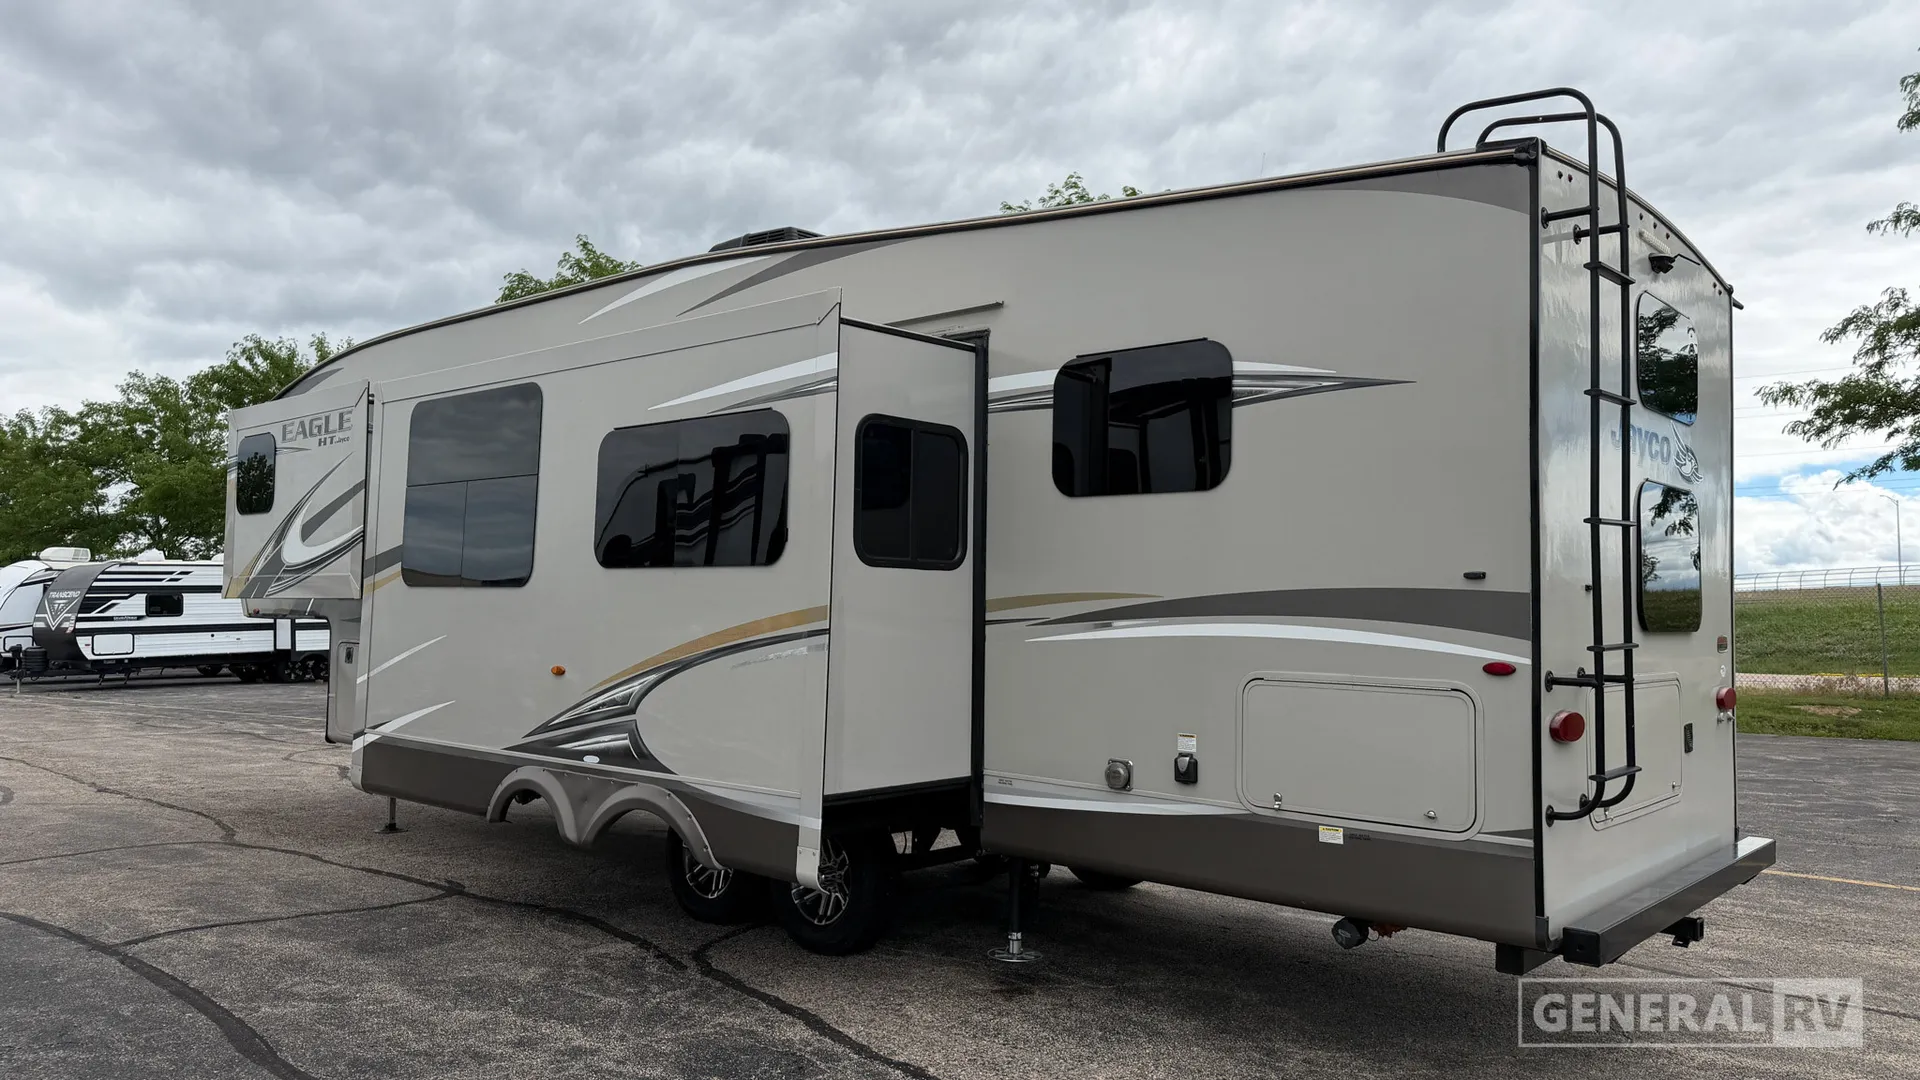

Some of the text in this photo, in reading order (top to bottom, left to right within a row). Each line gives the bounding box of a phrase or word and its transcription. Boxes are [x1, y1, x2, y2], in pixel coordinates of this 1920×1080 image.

[282, 410, 353, 442] EAGLE
[318, 436, 336, 447] HT
[49, 590, 81, 598] TRANSCEND
